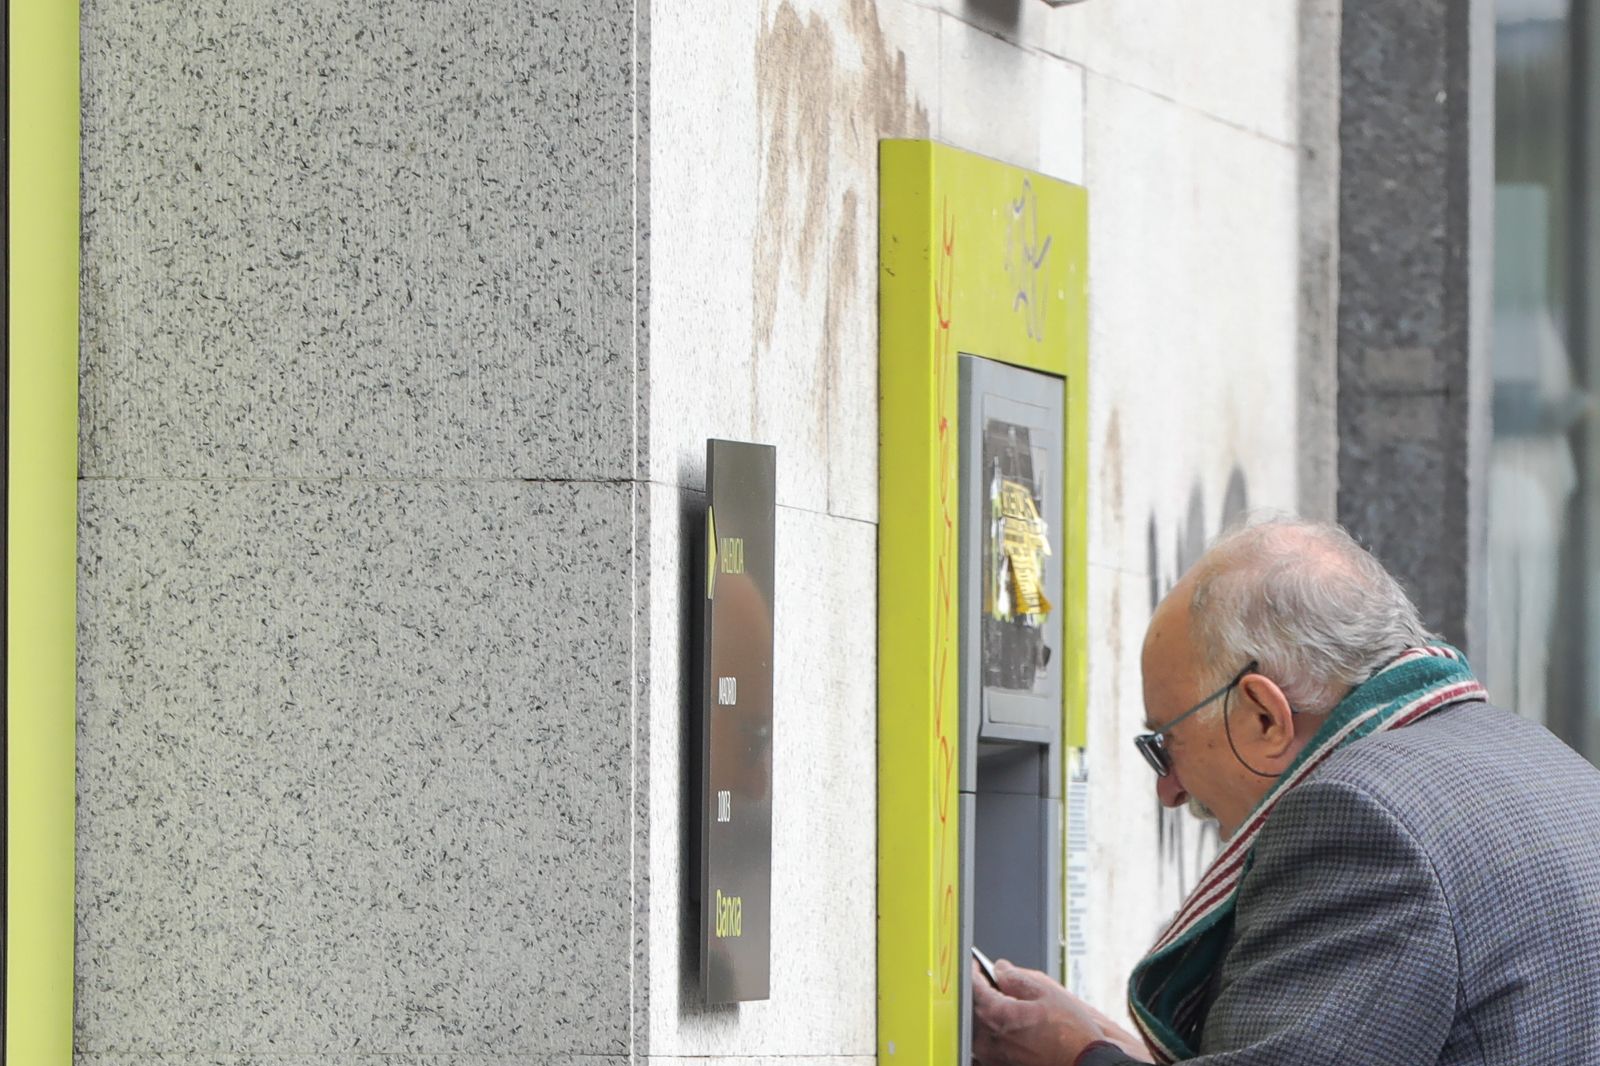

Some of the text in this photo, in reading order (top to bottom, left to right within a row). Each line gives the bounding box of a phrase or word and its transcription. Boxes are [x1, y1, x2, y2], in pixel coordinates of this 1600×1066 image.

[720, 537, 744, 574] VALENCIA
[718, 676, 737, 705] MADRID
[716, 888, 742, 938] Bankia
